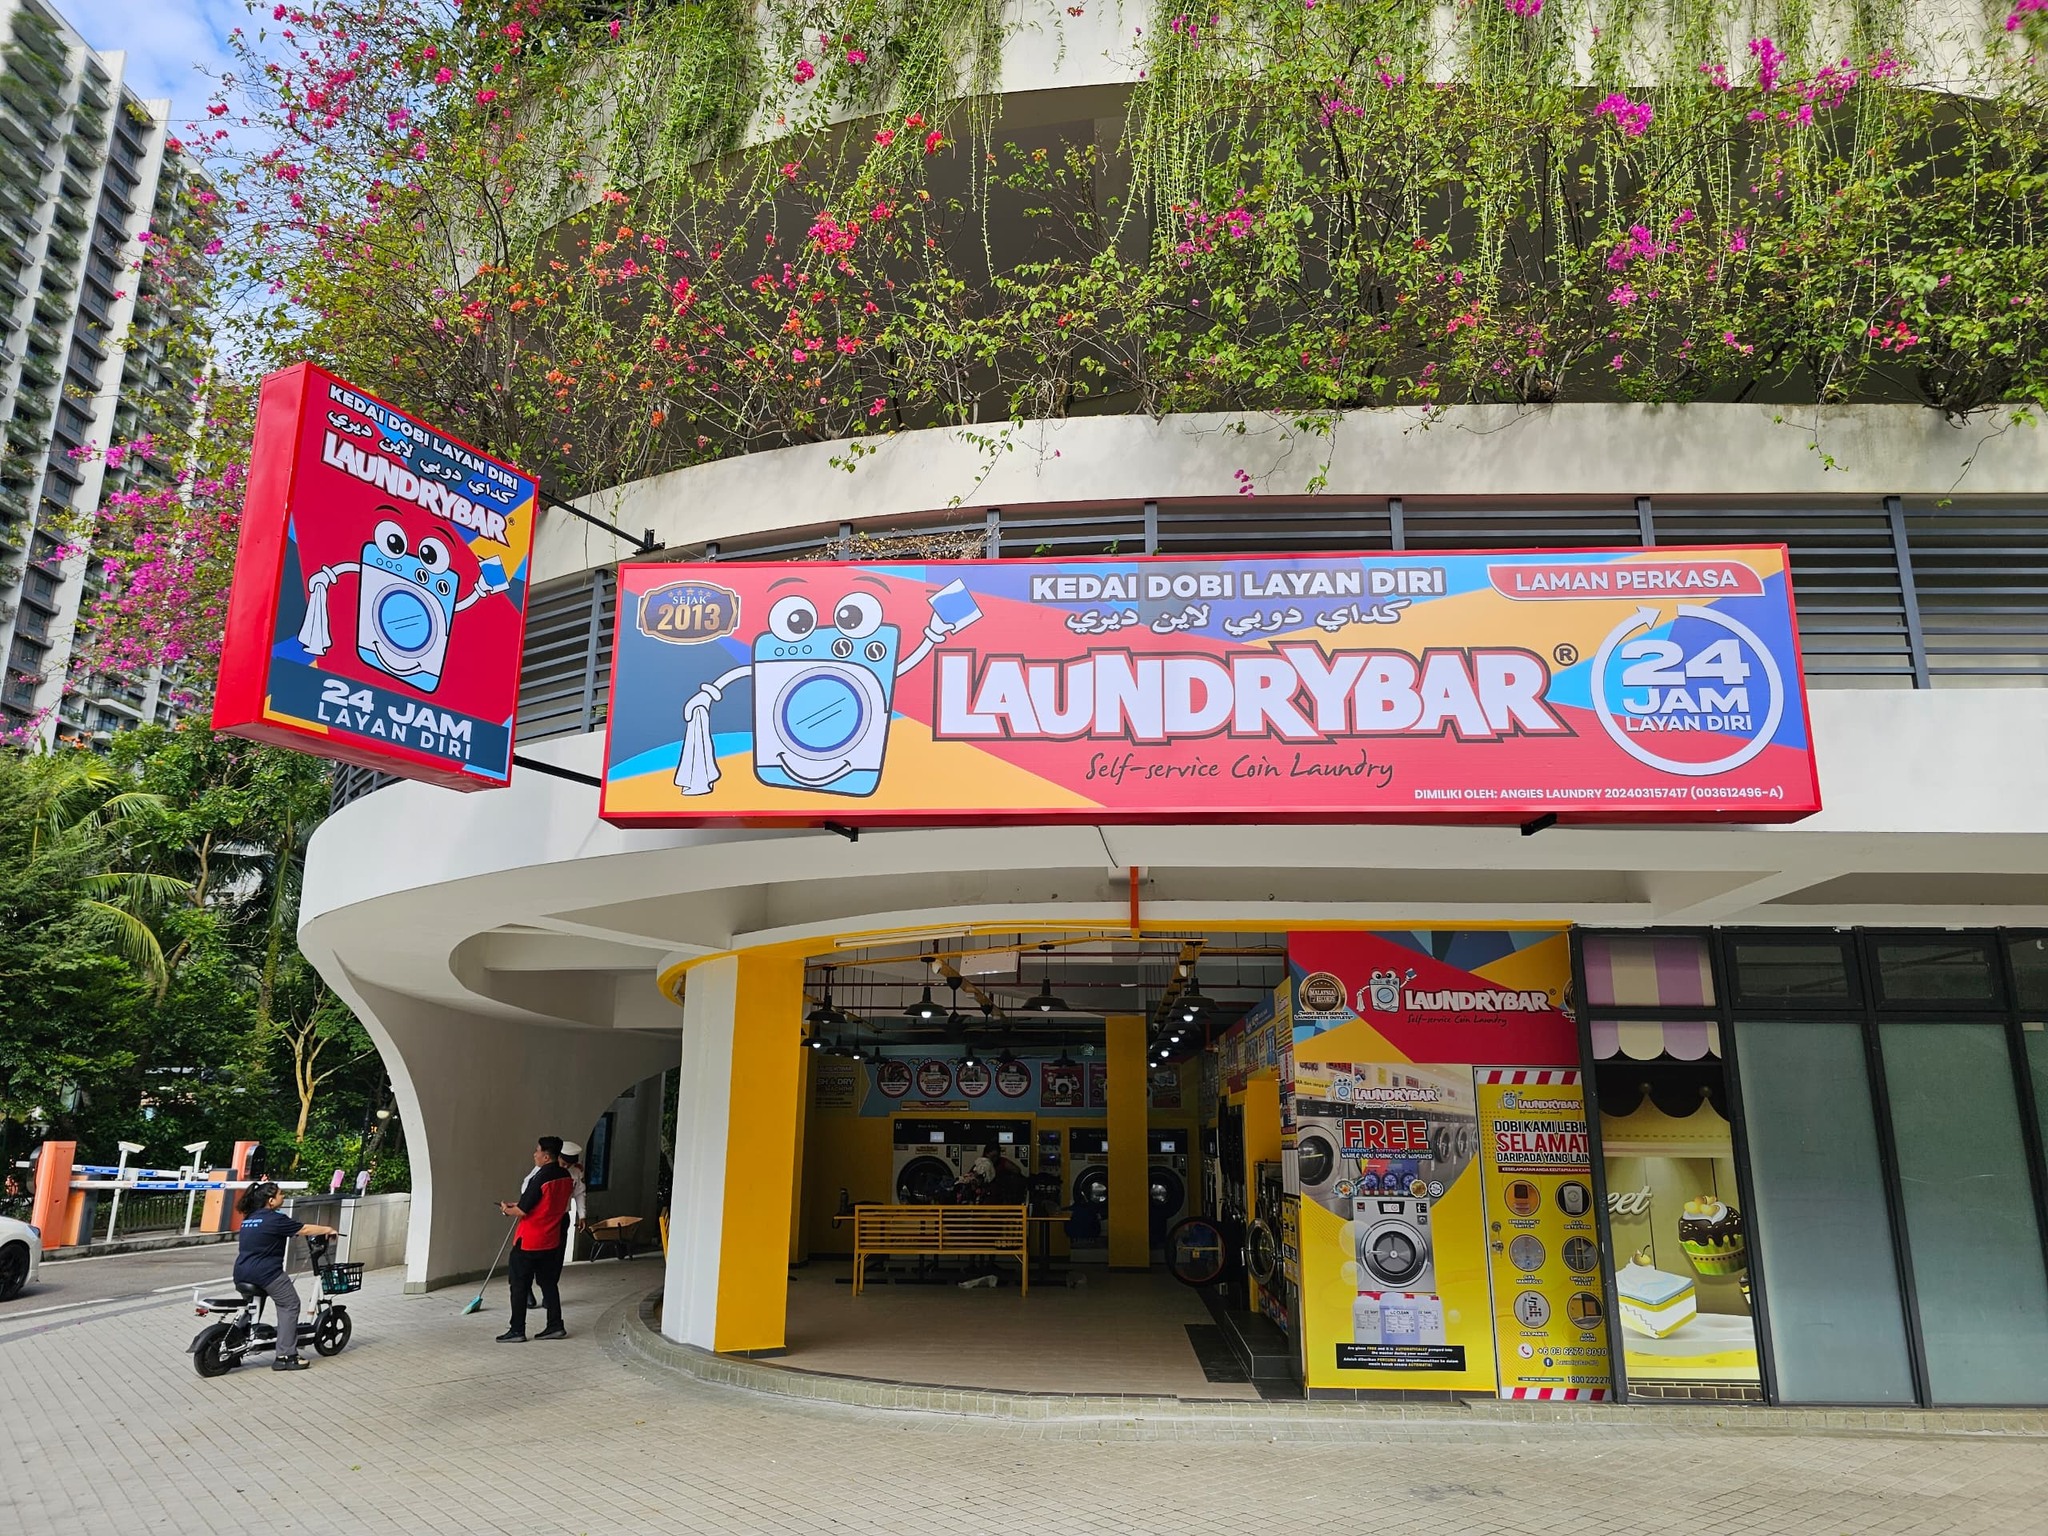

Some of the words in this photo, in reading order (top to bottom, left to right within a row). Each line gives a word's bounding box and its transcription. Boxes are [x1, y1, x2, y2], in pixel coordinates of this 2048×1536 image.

[330, 384, 384, 424] KEDAI
[388, 415, 429, 447] DOBI
[433, 438, 485, 474] LAYAN
[488, 465, 518, 491] DIRI
[322, 429, 511, 547] LAUNDRYBAR
[1032, 575, 1137, 600] KEDAI
[1148, 574, 1233, 598] DOBI
[1243, 571, 1361, 597] LAYAN
[1371, 570, 1444, 594] DIRI
[1516, 571, 1609, 591] LAMAN
[1616, 568, 1739, 590] PERKASA
[672, 596, 707, 605] SEJAK
[657, 603, 721, 631] 2013
[1066, 608, 1139, 634] ديري
[1224, 607, 1302, 636] دوبي
[1317, 599, 1411, 632] كداي
[1620, 638, 1751, 686] 24
[934, 643, 1574, 741] LAUNDRYBAR
[1621, 687, 1750, 714] JAM
[321, 679, 374, 714] 24
[388, 702, 472, 743] JAM
[1626, 715, 1701, 732] LAYAN
[1706, 715, 1752, 731] DIRI
[317, 701, 407, 742] LAYAN
[420, 731, 471, 760] DIRI
[1085, 752, 1221, 785] Self-service
[1231, 754, 1283, 779] Coin
[1290, 748, 1394, 788] Laundry
[1414, 788, 1462, 800] DIMILIKI
[1464, 788, 1498, 799] OLEH:
[1500, 788, 1544, 799] ANGIES
[1546, 788, 1602, 799] LAUNDRY
[1604, 787, 1688, 799] 202403157417
[1690, 785, 1784, 800] (003612496-A)
[1405, 989, 1551, 1012] LAUNDRYBAR
[1407, 1014, 1451, 1024] Self-service
[1455, 1014, 1470, 1024] Coin
[1474, 1014, 1508, 1027] Laundry
[1354, 1088, 1438, 1102] LAUNDRYBAR
[1518, 1099, 1582, 1110] LAUNDRYBAR
[1343, 1119, 1429, 1150] FREE
[1494, 1120, 1520, 1132] DOBI
[1524, 1121, 1555, 1132] KAMI
[1496, 1133, 1588, 1153] SELAMAT
[1497, 1153, 1542, 1163] DARIPADA
[1543, 1153, 1568, 1163] YANG
